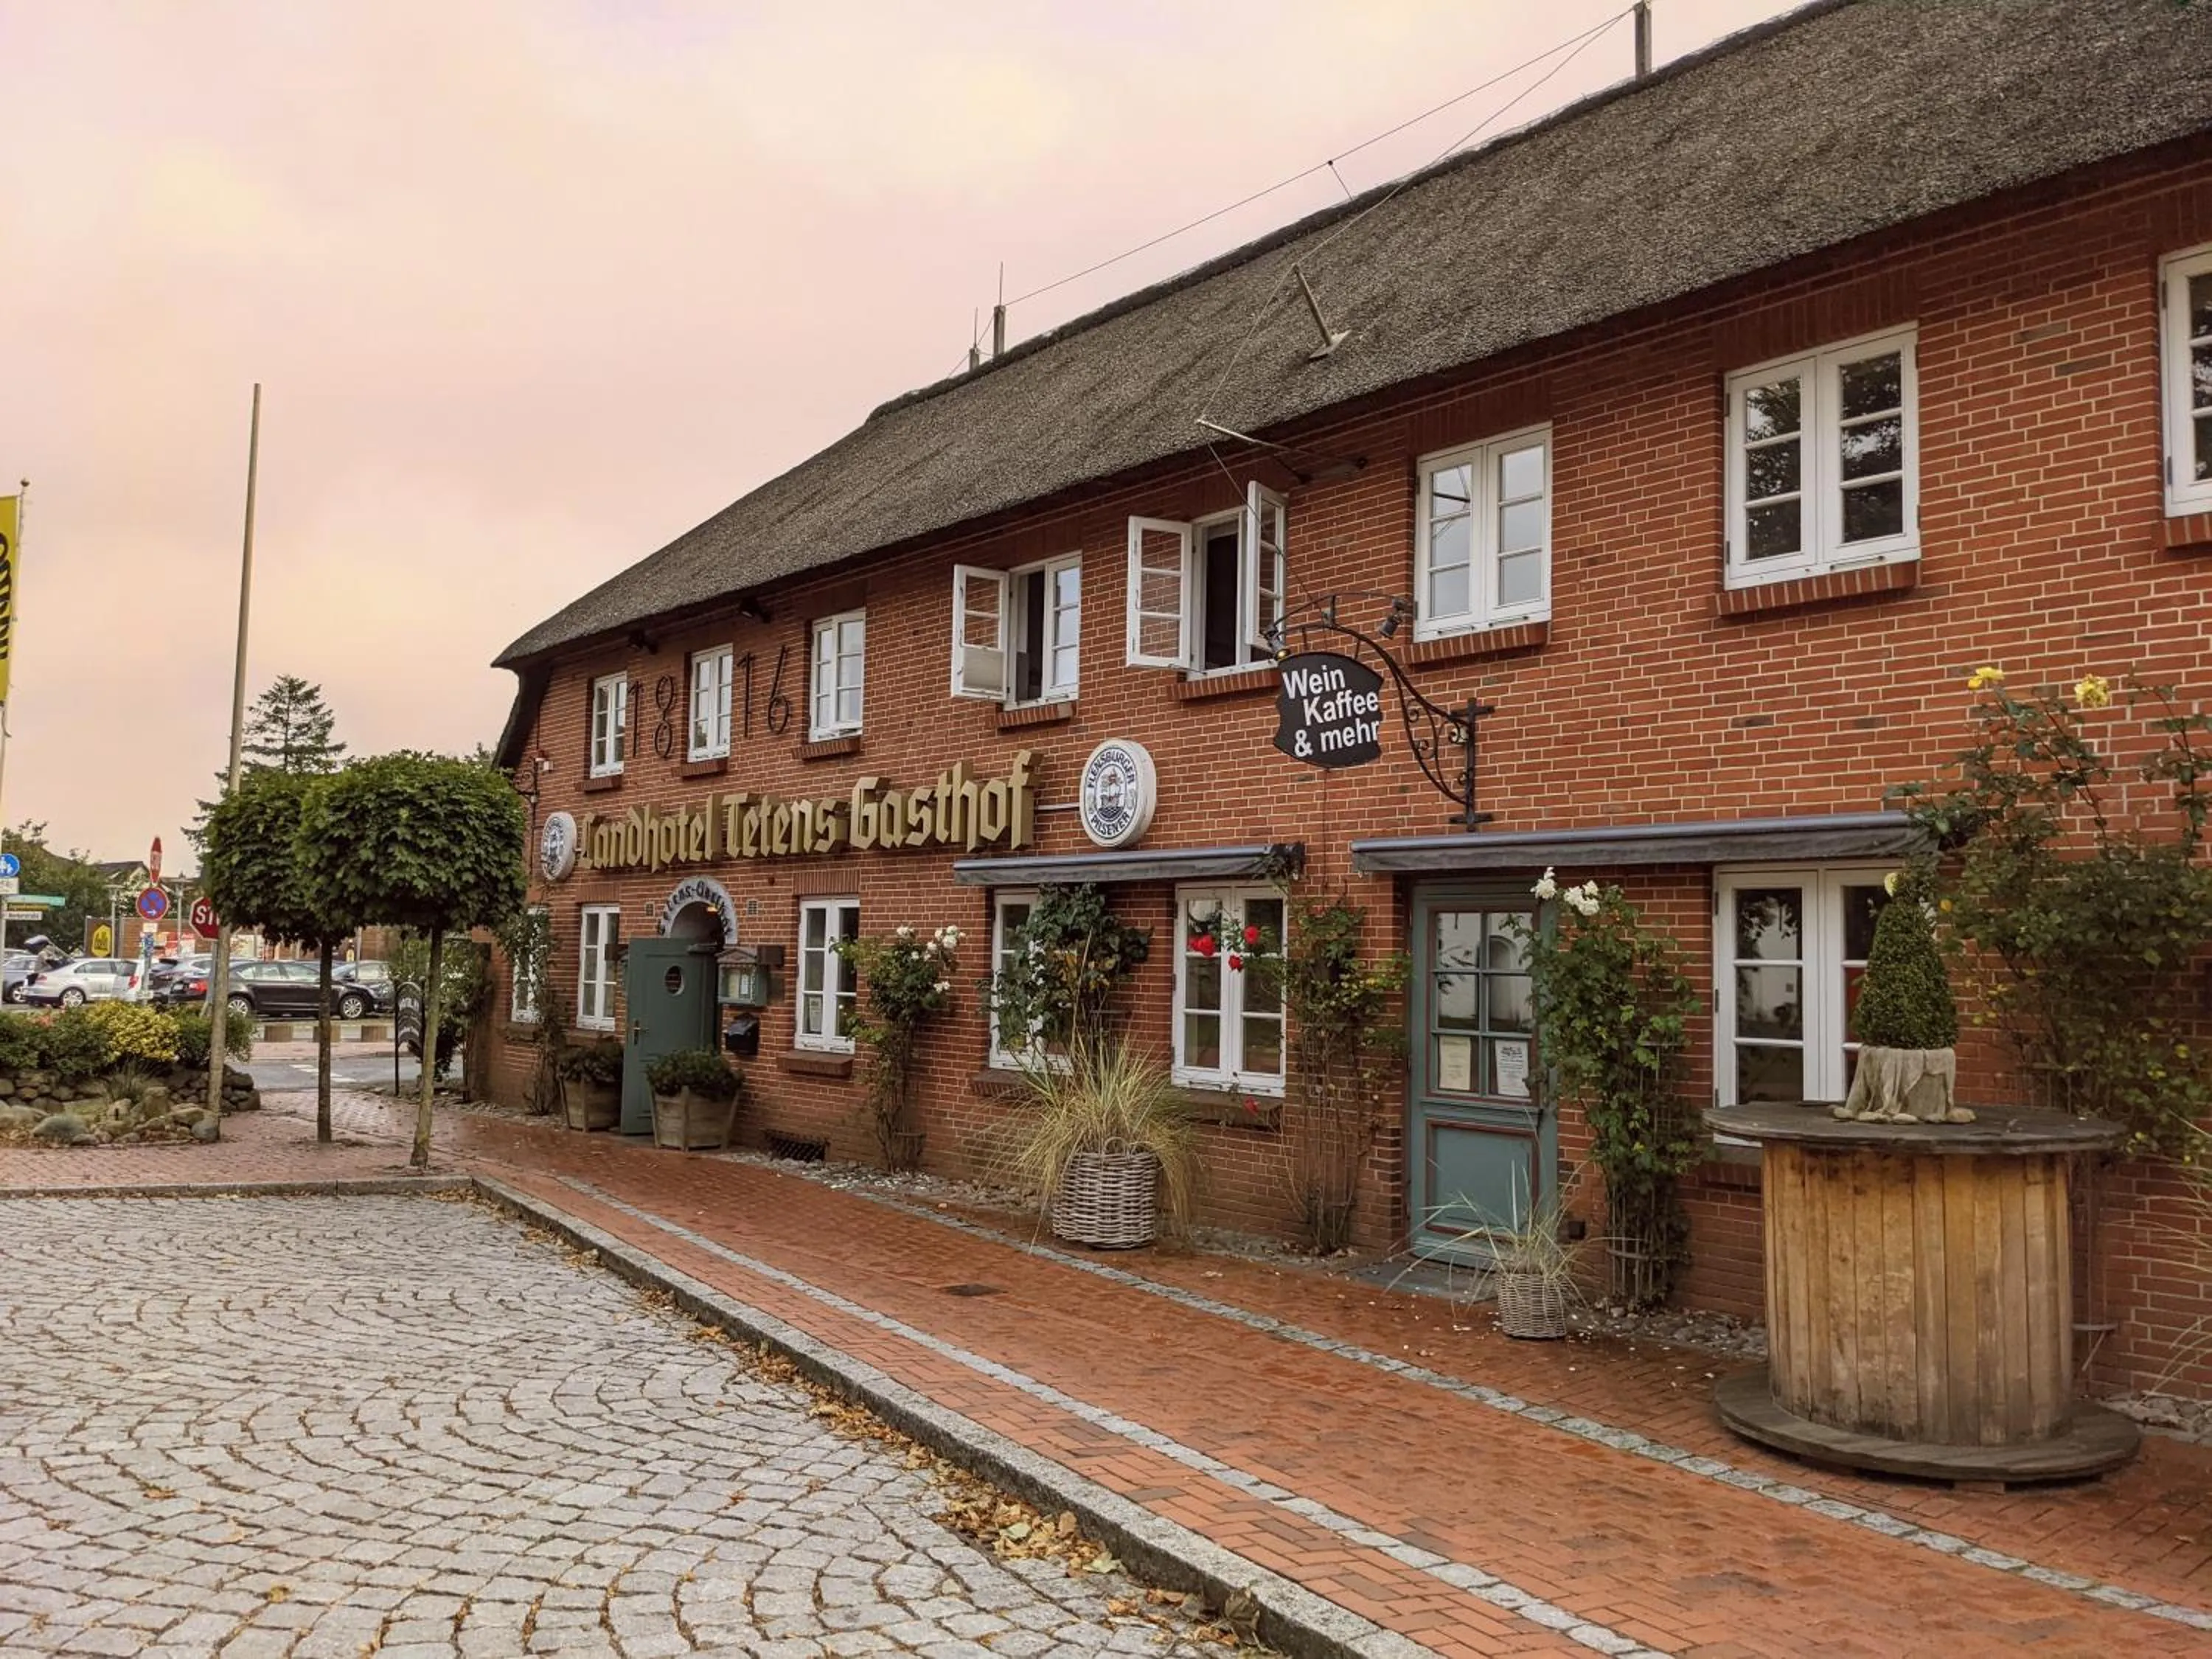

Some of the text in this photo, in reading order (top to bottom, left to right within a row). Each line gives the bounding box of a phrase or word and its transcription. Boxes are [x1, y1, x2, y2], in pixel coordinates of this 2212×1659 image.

[1281, 664, 1346, 700] Wein
[1303, 689, 1379, 726] Kaffee
[1293, 718, 1380, 757] & mehr
[1087, 748, 1135, 788] FLENSBURGER
[578, 795, 717, 873] Landhotel
[722, 793, 838, 858] Tetens
[850, 749, 1035, 853] Gasthof
[1091, 812, 1131, 836] PILSENER
